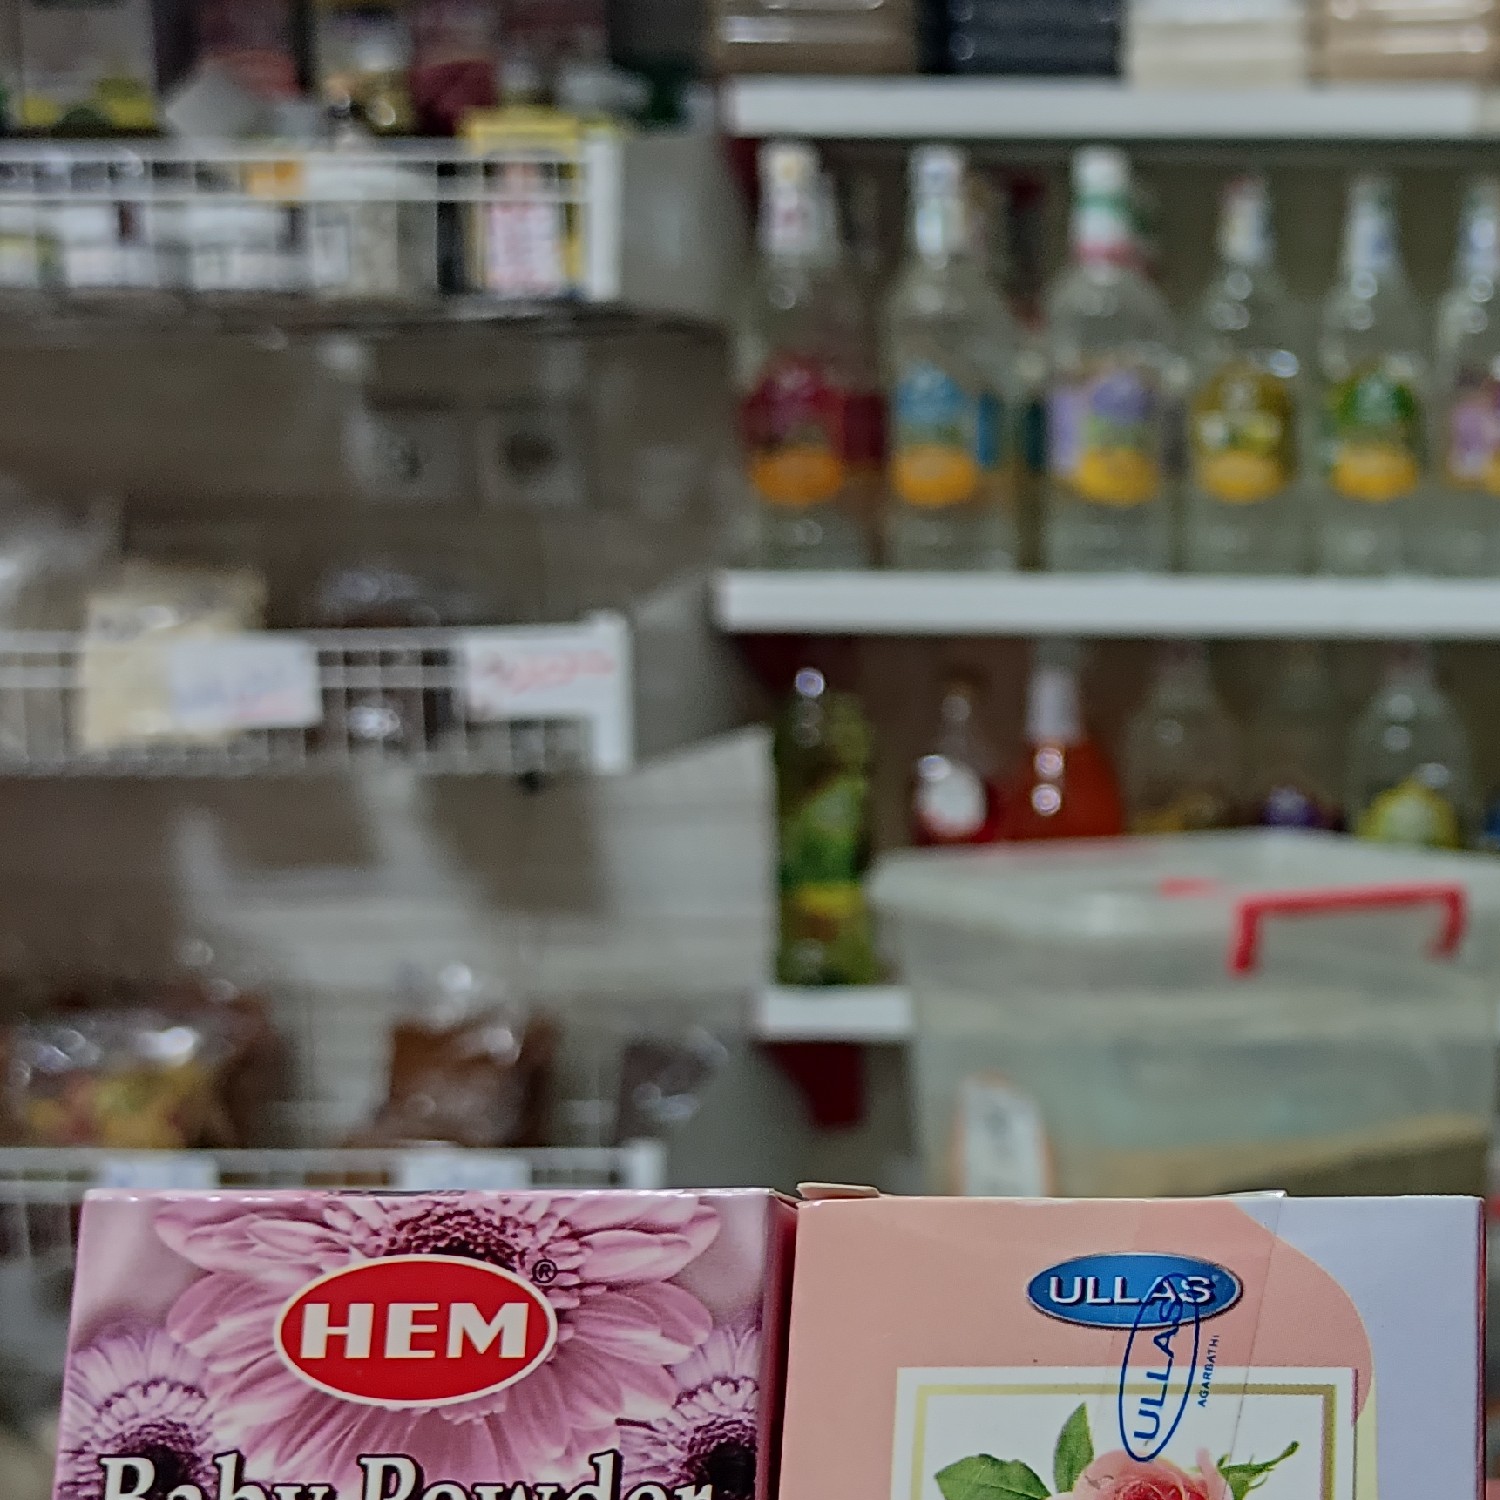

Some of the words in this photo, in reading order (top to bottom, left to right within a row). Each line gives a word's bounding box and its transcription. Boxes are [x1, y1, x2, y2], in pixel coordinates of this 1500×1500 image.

[1049, 1275, 1211, 1305] ULLAS
[301, 1302, 530, 1360] HEM
[1133, 1298, 1184, 1440] ULLAS
[1197, 1334, 1220, 1408] AGARBATHI
